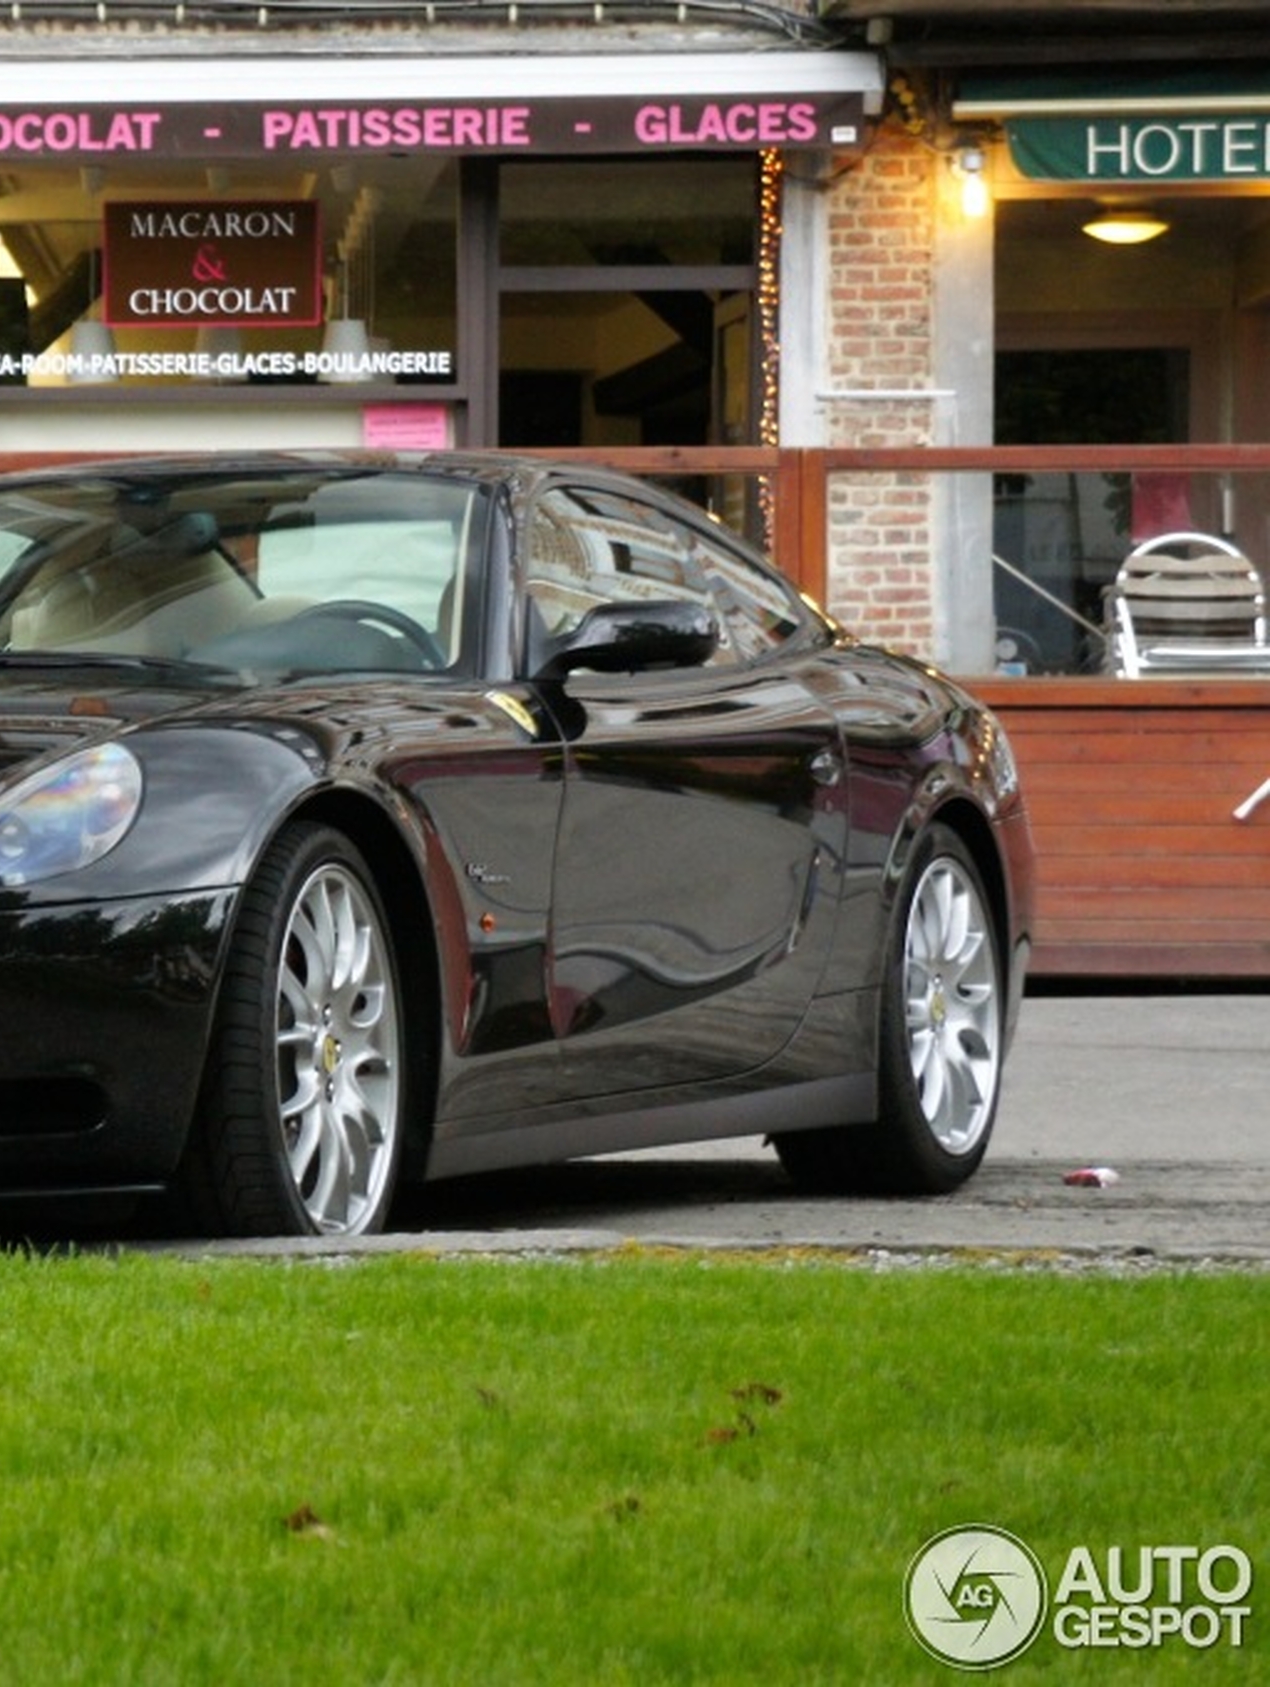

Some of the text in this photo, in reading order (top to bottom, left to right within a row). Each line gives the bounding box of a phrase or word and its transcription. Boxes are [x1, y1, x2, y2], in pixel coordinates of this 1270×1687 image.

[262, 107, 530, 149] PATISSERIE
[634, 103, 817, 143] GLACES
[1086, 123, 1270, 175] HOTE
[130, 212, 296, 238] MACARON
[192, 244, 226, 281] &
[129, 287, 297, 315] CHOCOLAT
